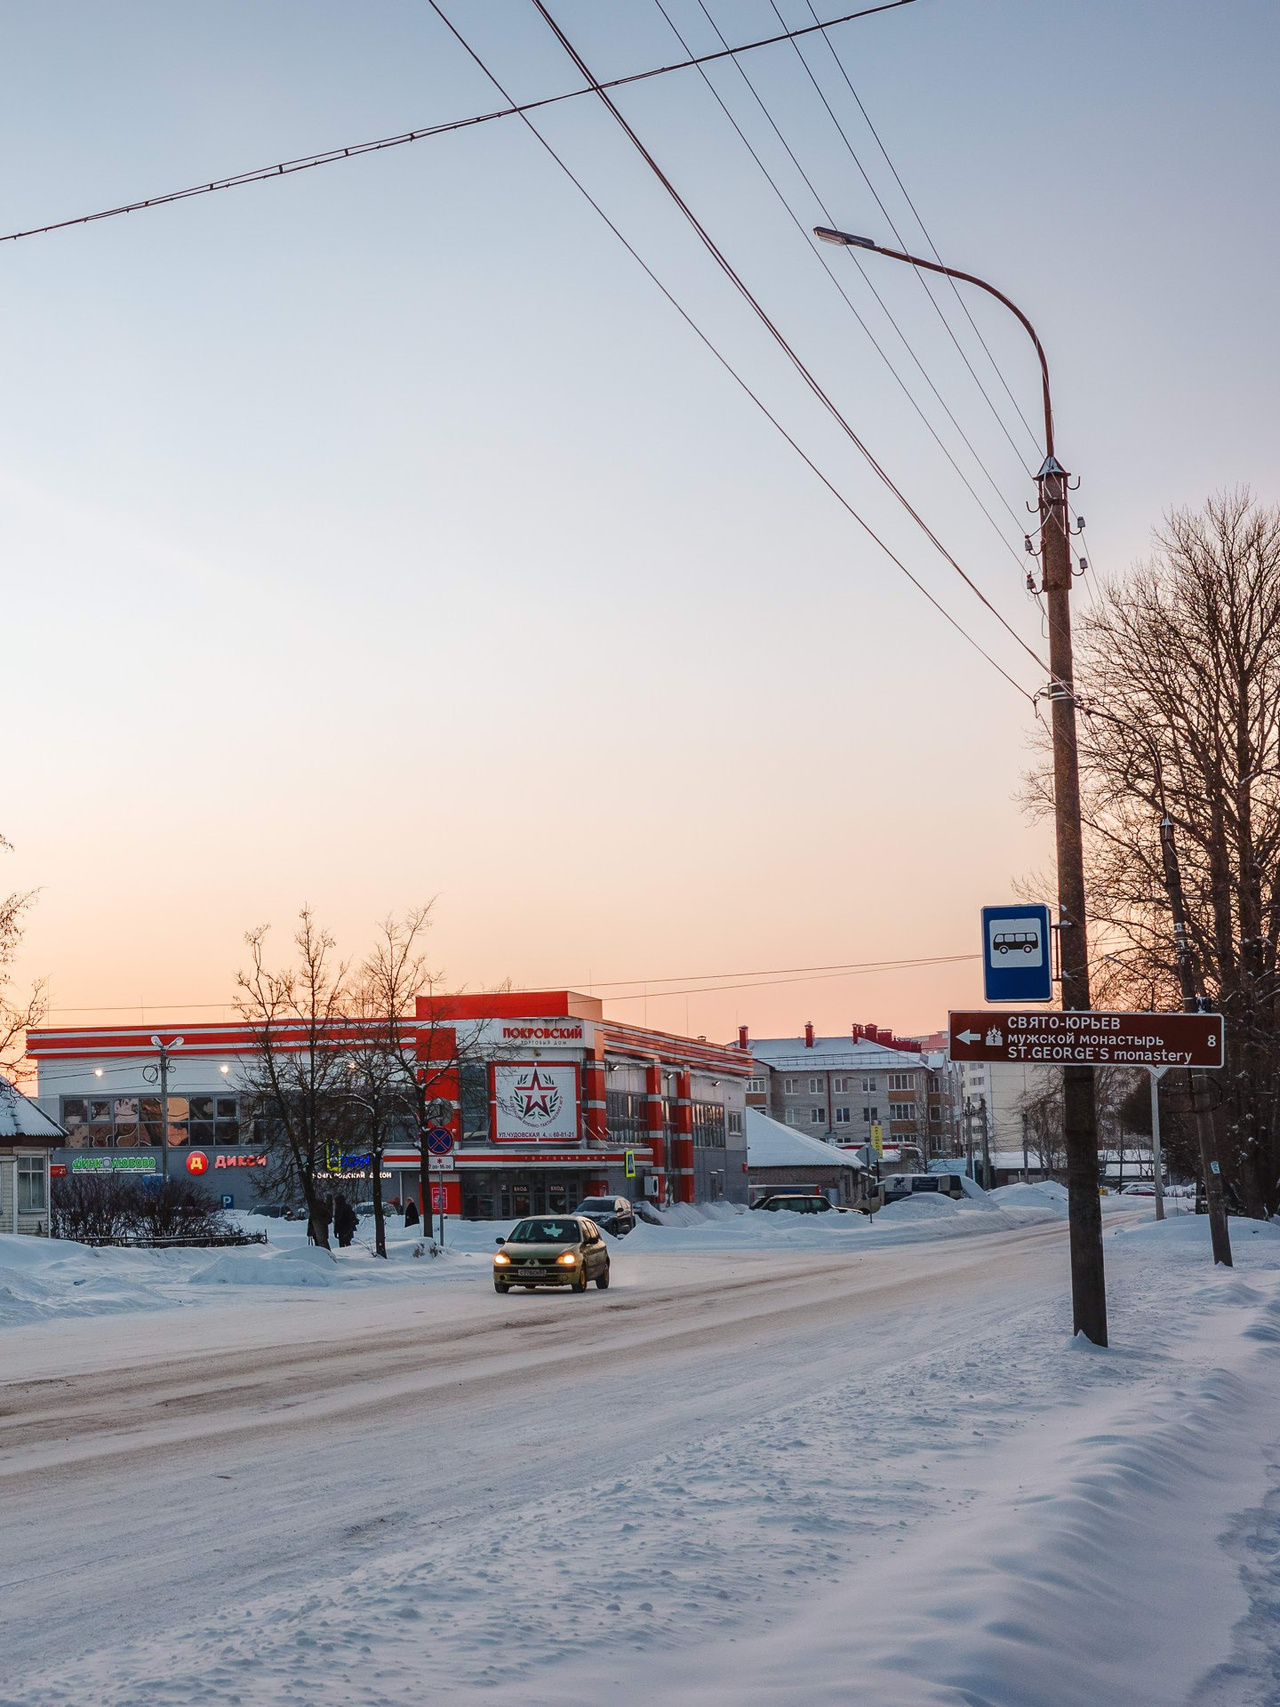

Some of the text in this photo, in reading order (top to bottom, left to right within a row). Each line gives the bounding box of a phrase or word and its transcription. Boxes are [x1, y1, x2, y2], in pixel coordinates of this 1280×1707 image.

[1007, 1016, 1120, 1029] СВЯТО-ЮРЬЕВ
[502, 1025, 583, 1039] ПОКРОВСКИЙ
[1007, 1032, 1164, 1047] мужской монастырь
[1207, 1035, 1216, 1047] 8
[1007, 1046, 1193, 1064] ST.GEORGE'S monastery
[190, 1154, 267, 1170] Д ДИКСИ
[222, 1196, 232, 1207] P
